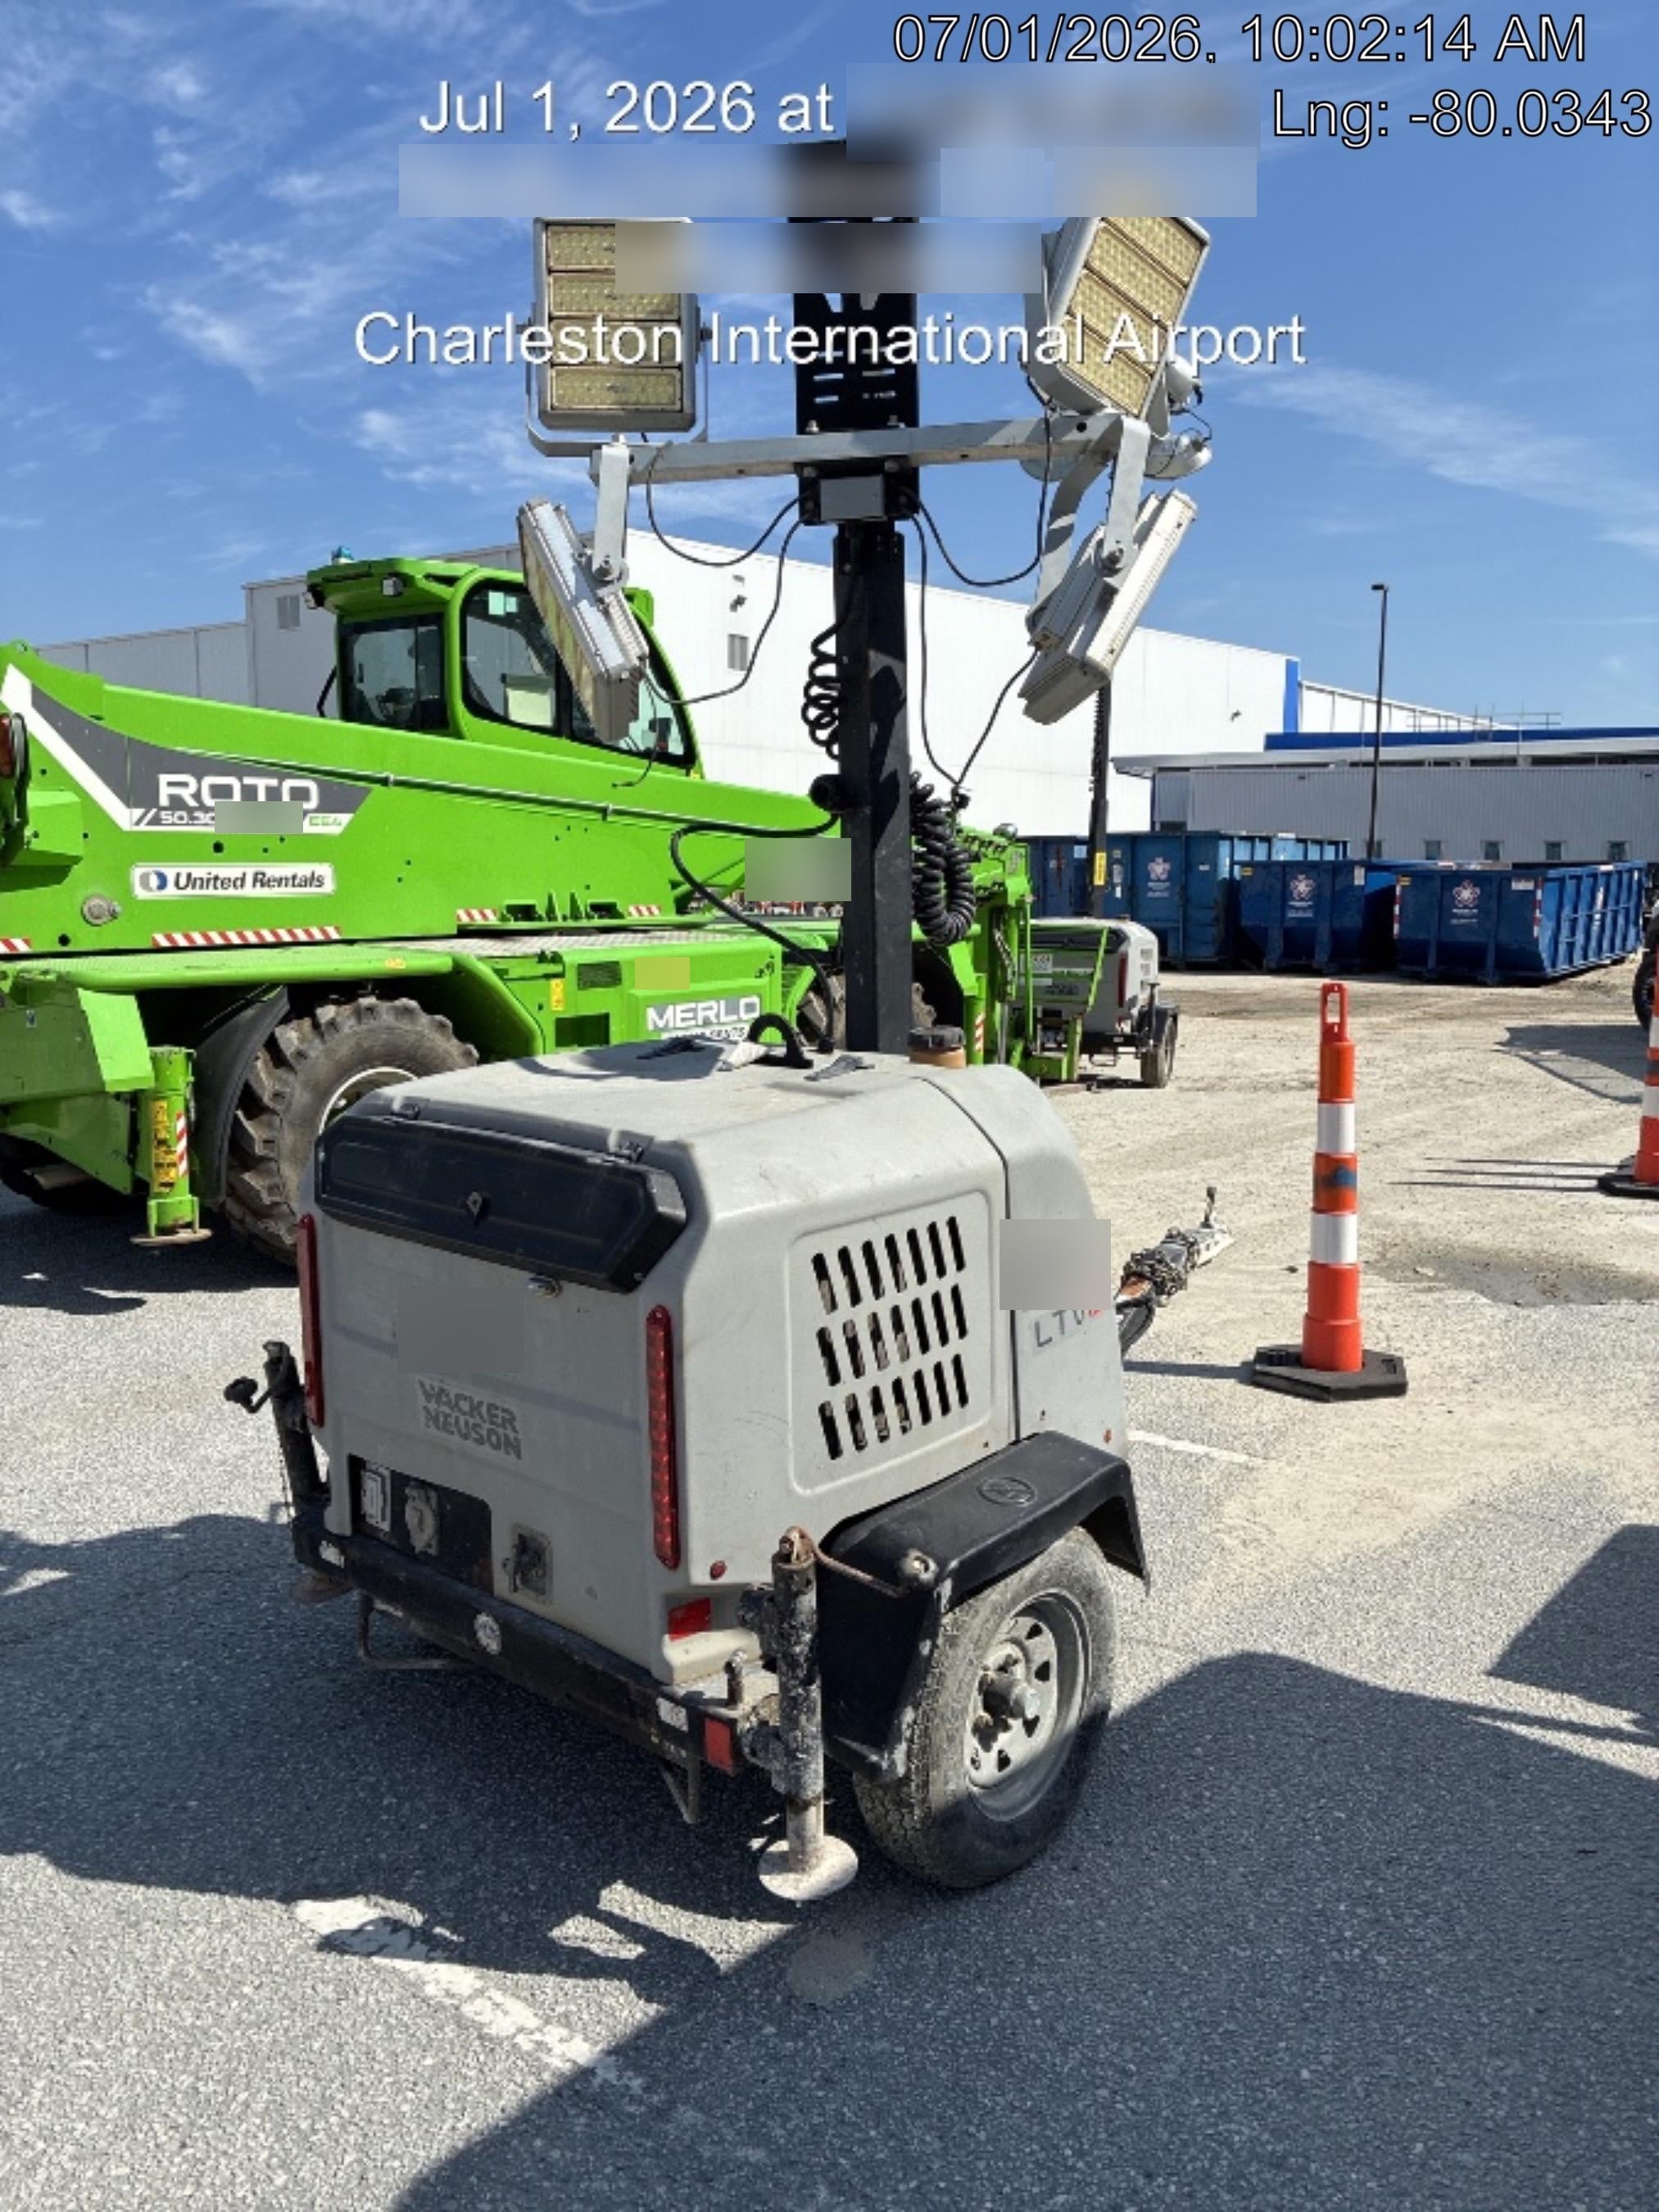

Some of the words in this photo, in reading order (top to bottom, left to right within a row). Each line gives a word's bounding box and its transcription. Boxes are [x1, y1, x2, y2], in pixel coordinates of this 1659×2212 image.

[157, 773, 320, 809] ROTO
[174, 871, 247, 891] United
[251, 868, 325, 891] Rentals
[646, 995, 760, 1031] MERLO
[421, 1405, 522, 1461] NEUSON
